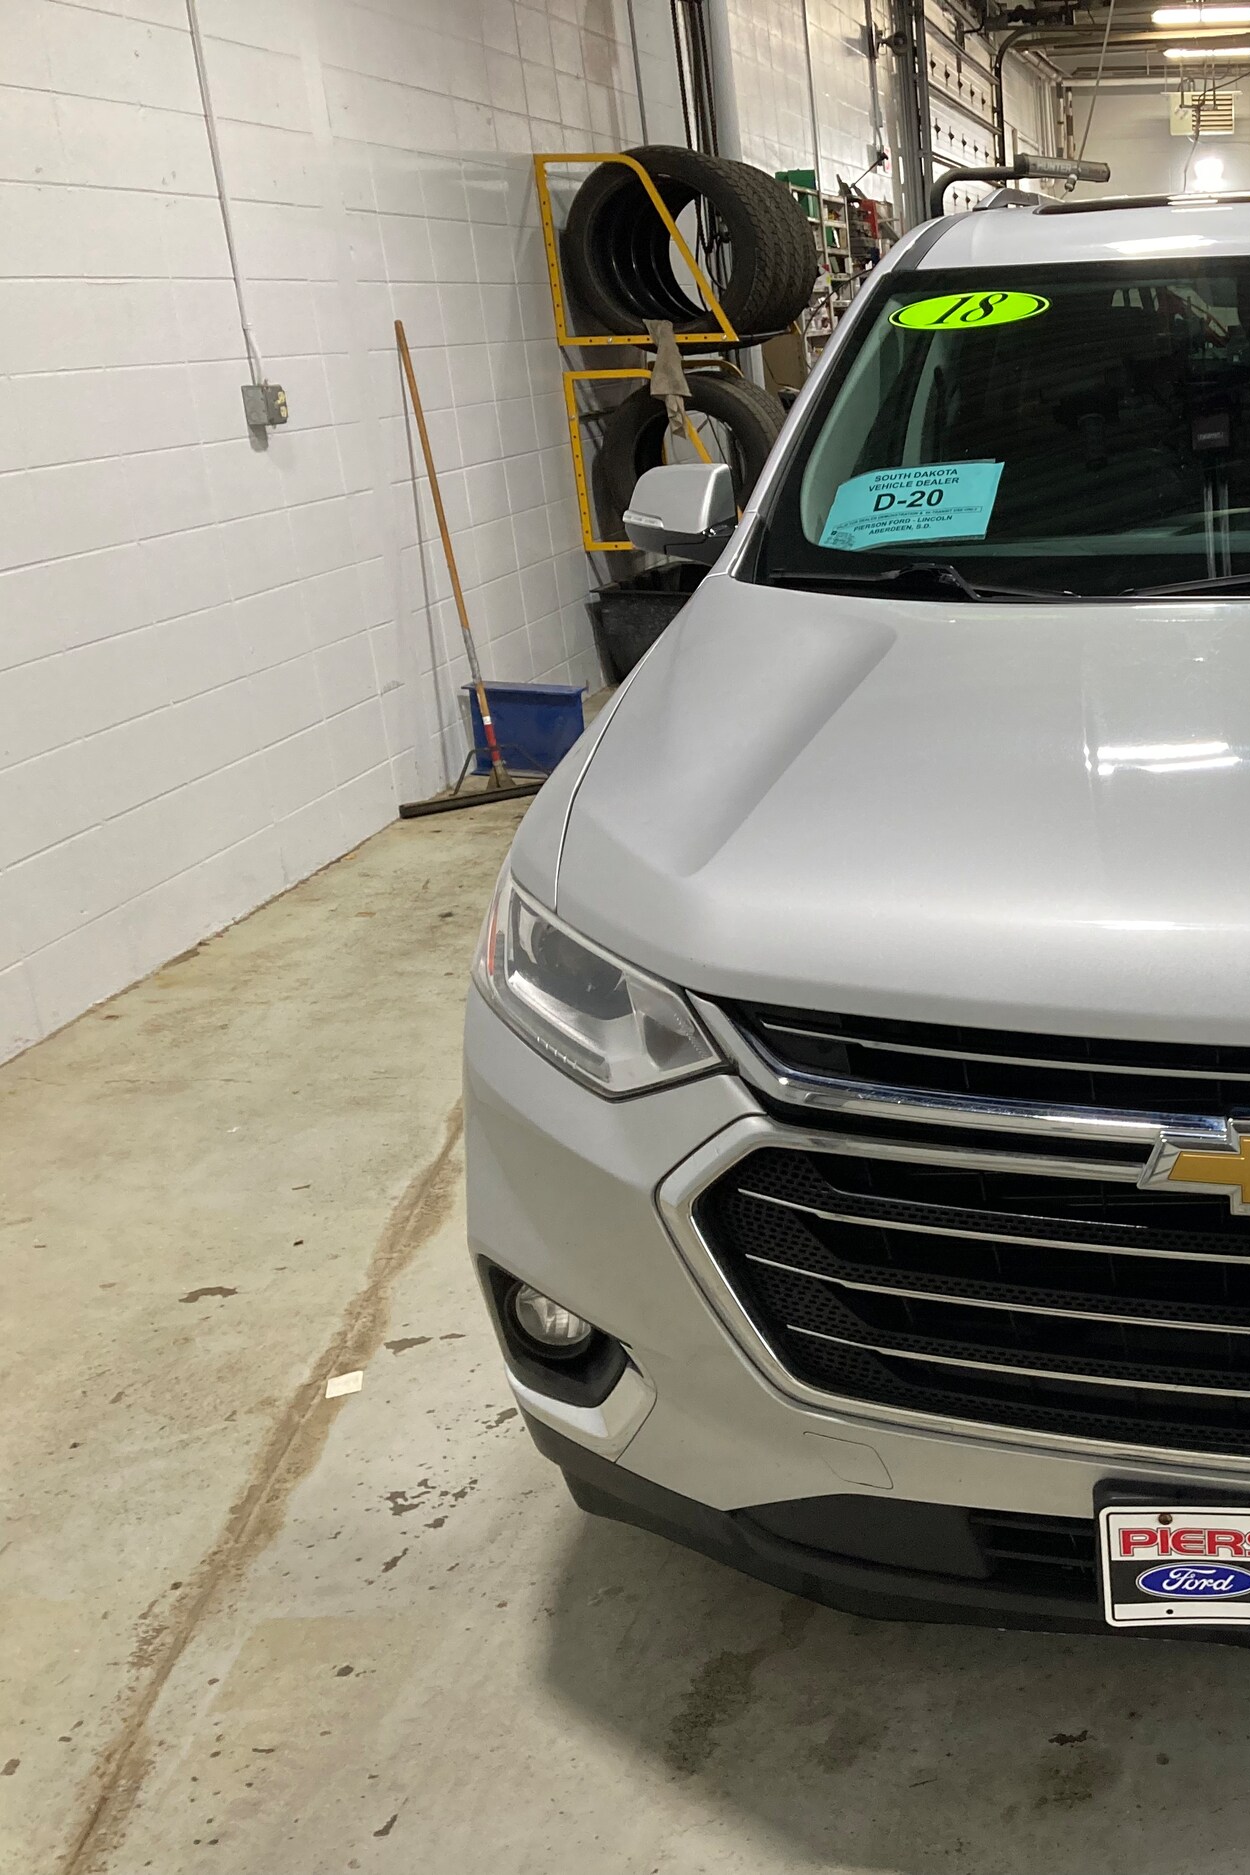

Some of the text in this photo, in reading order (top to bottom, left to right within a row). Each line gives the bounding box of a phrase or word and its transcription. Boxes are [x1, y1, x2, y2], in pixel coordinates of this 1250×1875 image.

[1036, 162, 1072, 172] HUNTER
[924, 292, 1009, 326] 18
[874, 468, 959, 483] SOUTH DAKOTA
[869, 477, 960, 492] VEHICLE DEALER
[872, 489, 944, 513] D-20
[853, 520, 887, 532] PIERSON
[888, 517, 911, 526] FORD
[917, 515, 953, 523] LINCOLN
[868, 524, 914, 535] ABERDEEN,
[1161, 1567, 1235, 1592] Ford
